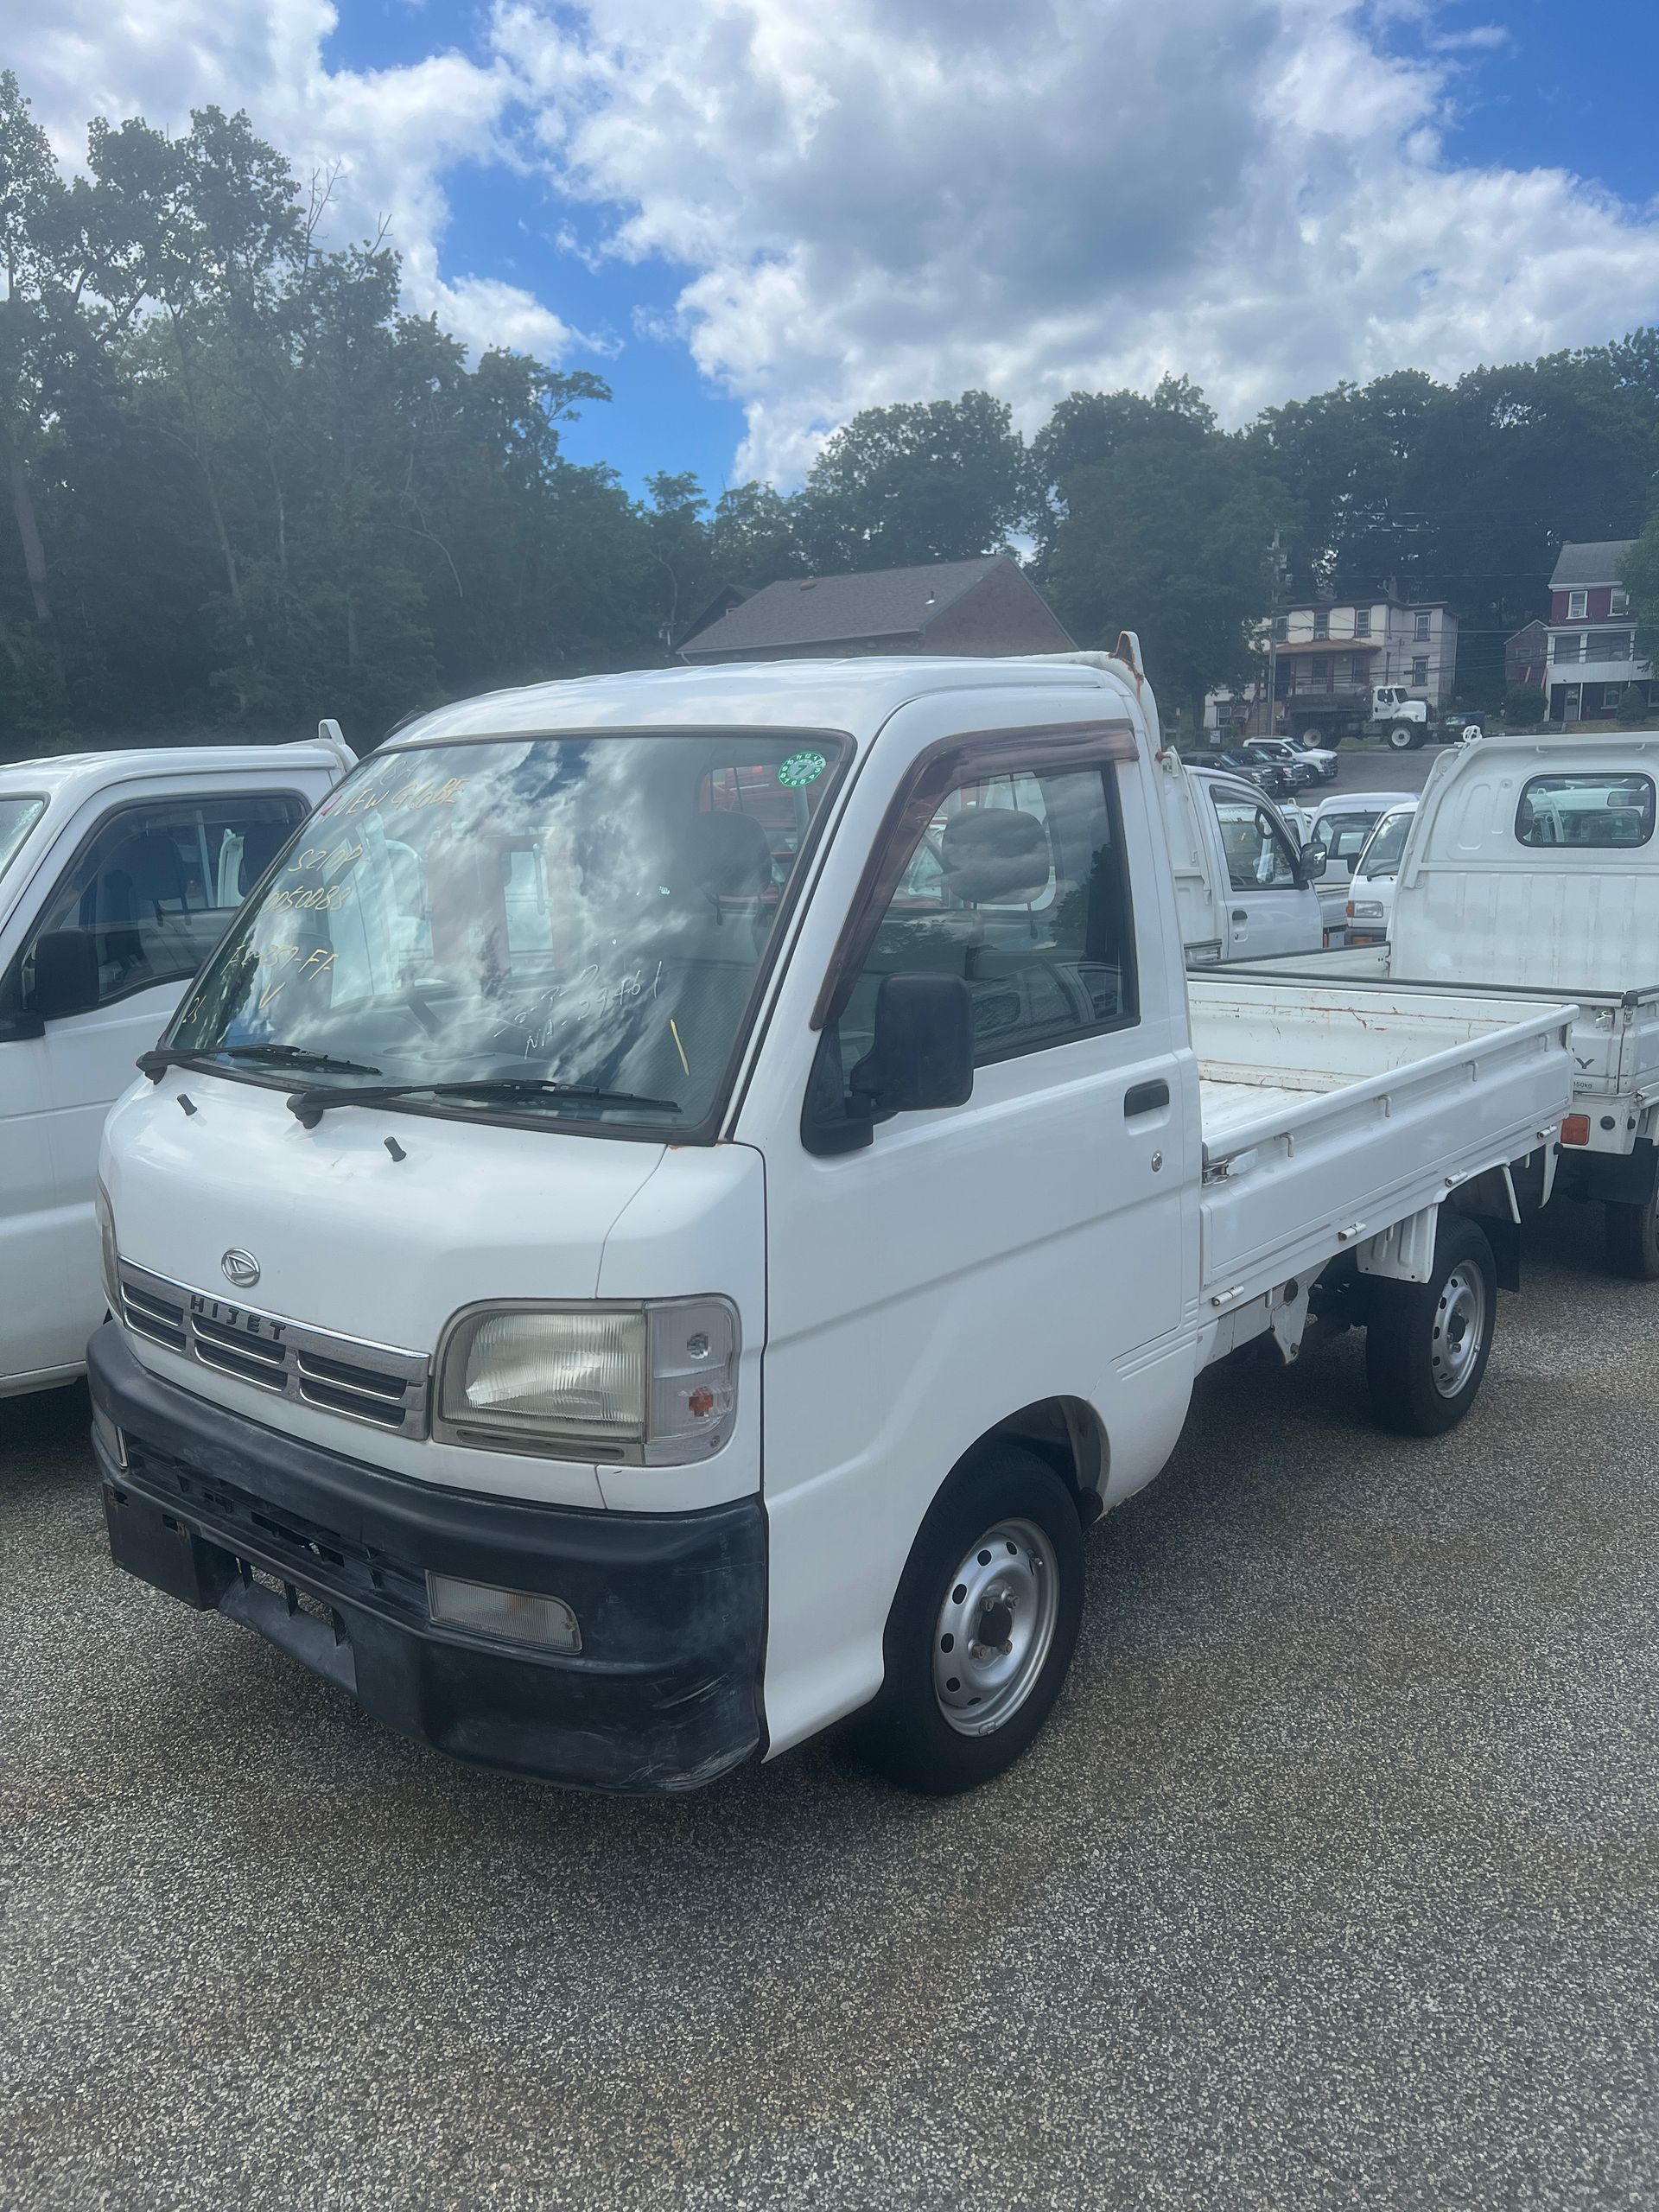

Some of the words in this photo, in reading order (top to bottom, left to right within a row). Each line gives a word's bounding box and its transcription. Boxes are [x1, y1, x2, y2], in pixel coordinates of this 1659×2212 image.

[795, 765, 807, 775] 7
[321, 788, 389, 823] NEW
[190, 1294, 287, 1340] HIJET
